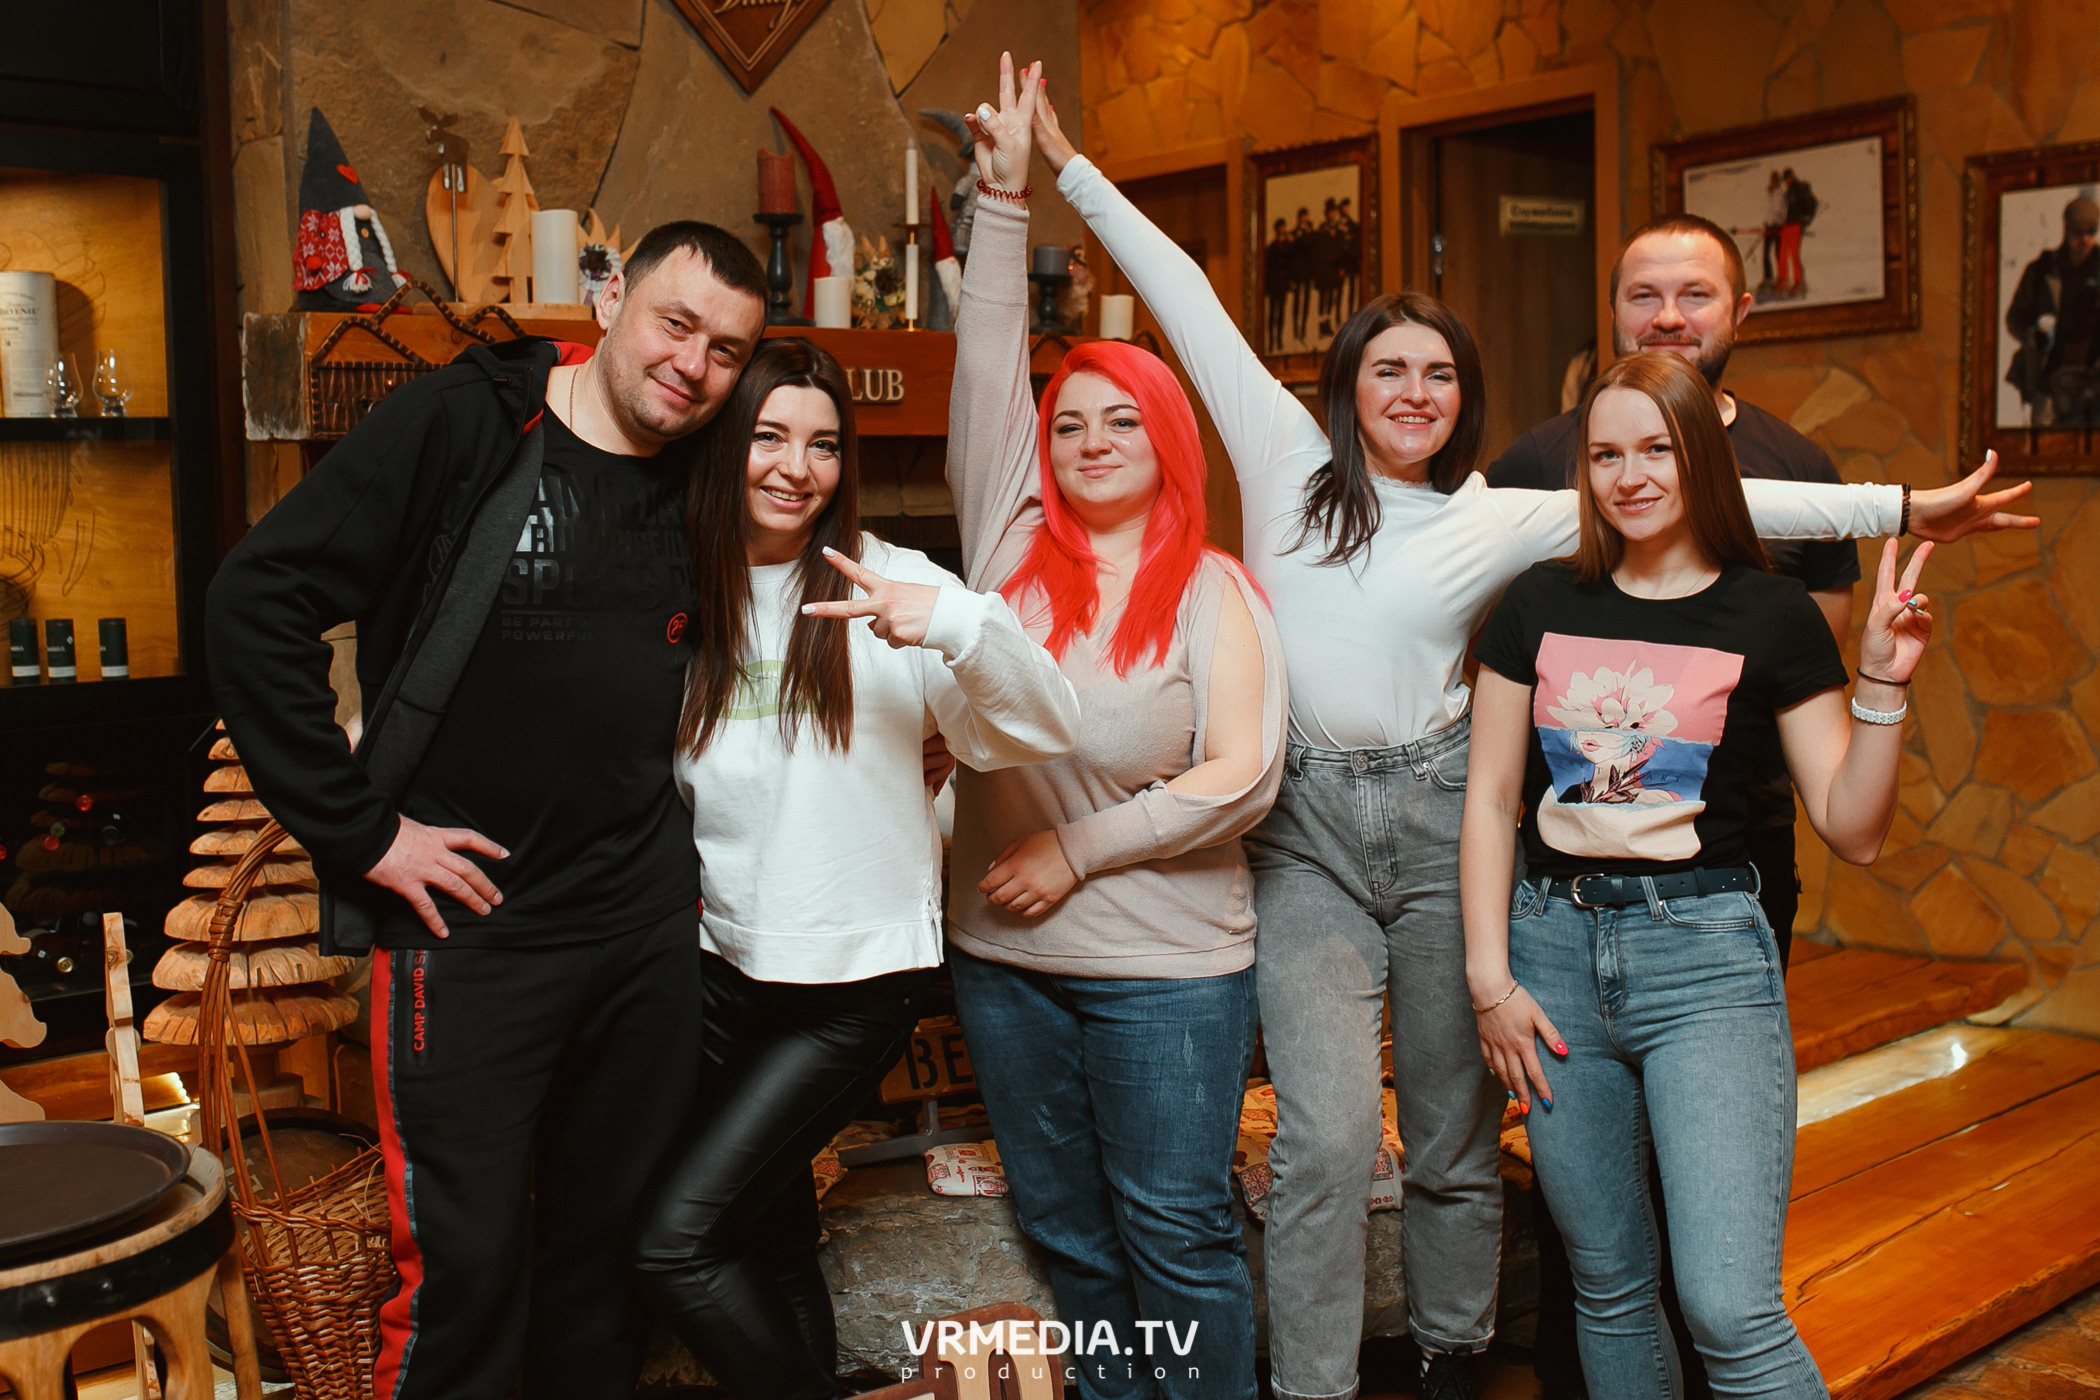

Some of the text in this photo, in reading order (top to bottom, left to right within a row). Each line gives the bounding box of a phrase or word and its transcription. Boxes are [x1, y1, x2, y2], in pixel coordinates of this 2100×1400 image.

[845, 368, 905, 401] LUB
[413, 967, 426, 1010] DAVID
[413, 1011, 426, 1052] CAMP
